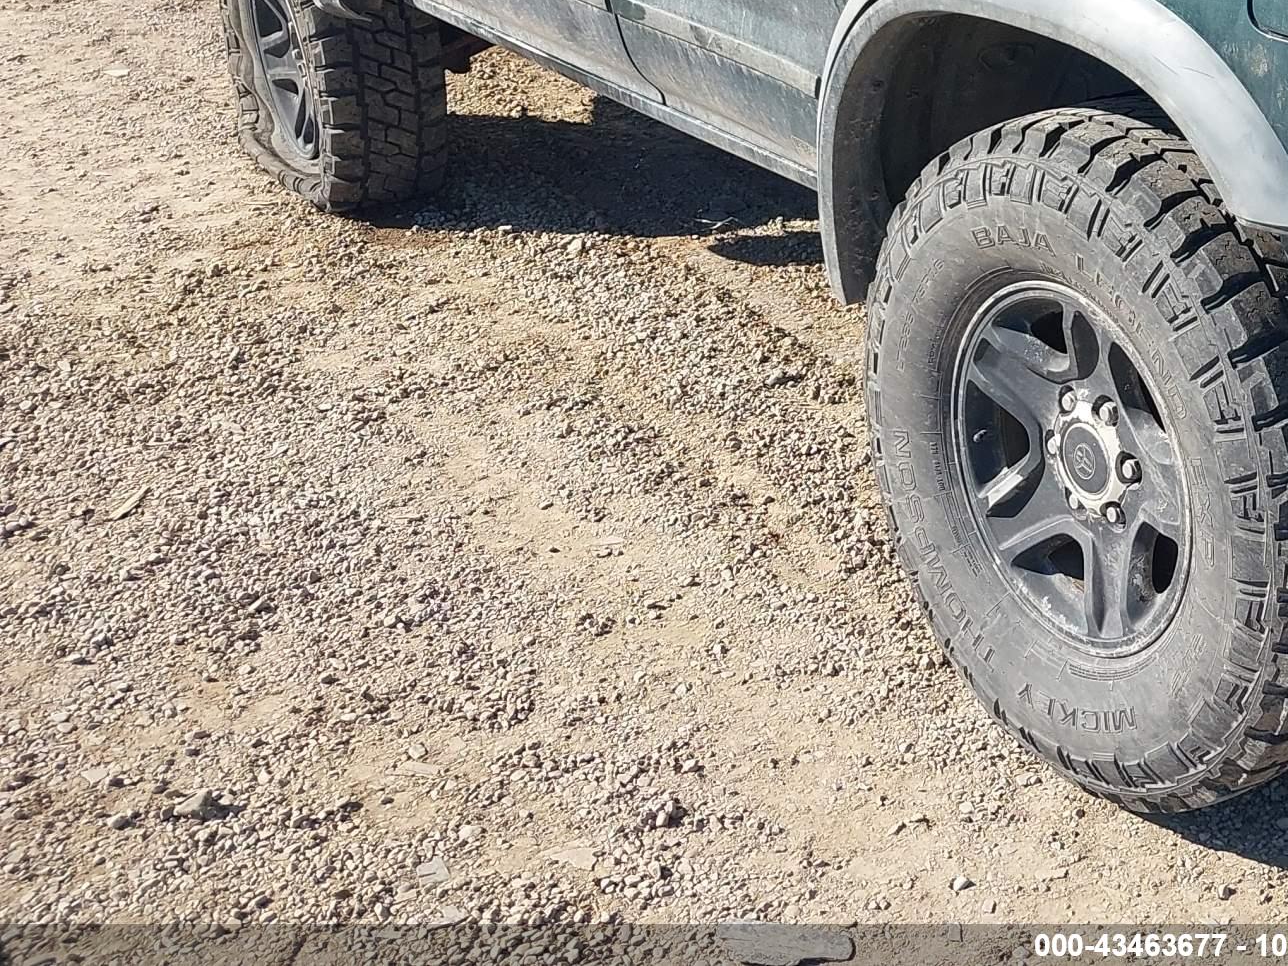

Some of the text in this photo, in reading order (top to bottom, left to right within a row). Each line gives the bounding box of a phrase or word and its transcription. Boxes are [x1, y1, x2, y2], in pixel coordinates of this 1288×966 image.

[970, 225, 1057, 257] BAJA
[1189, 457, 1216, 569] EXP
[892, 430, 997, 672] THOMPSON
[1016, 682, 1138, 734] MICKEY
